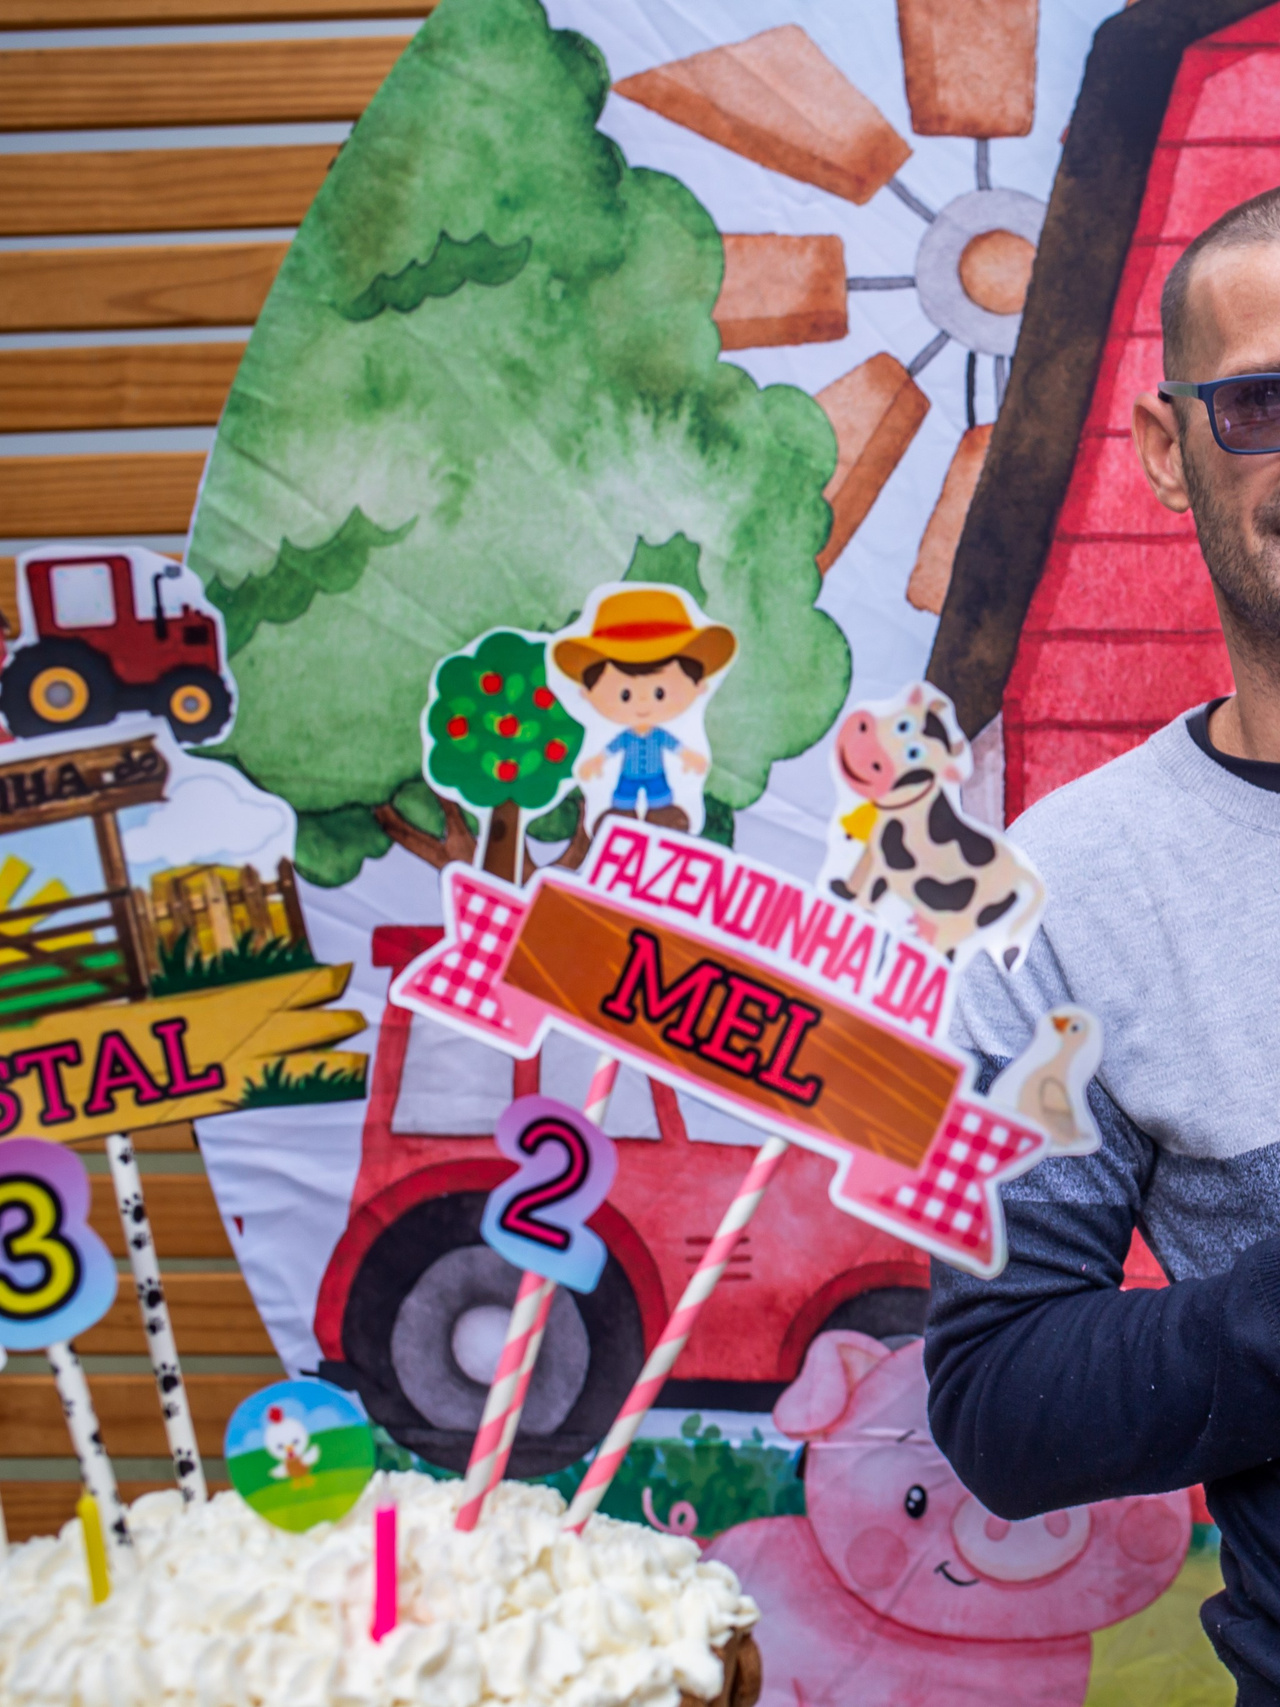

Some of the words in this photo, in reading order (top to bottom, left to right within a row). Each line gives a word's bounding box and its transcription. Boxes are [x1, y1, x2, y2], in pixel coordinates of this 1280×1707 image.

[588, 825, 876, 995] FAZENDINHA
[872, 942, 949, 1039] DA
[601, 927, 822, 1106] MEL
[0, 1174, 83, 1322] 3
[500, 1116, 590, 1251] 2
